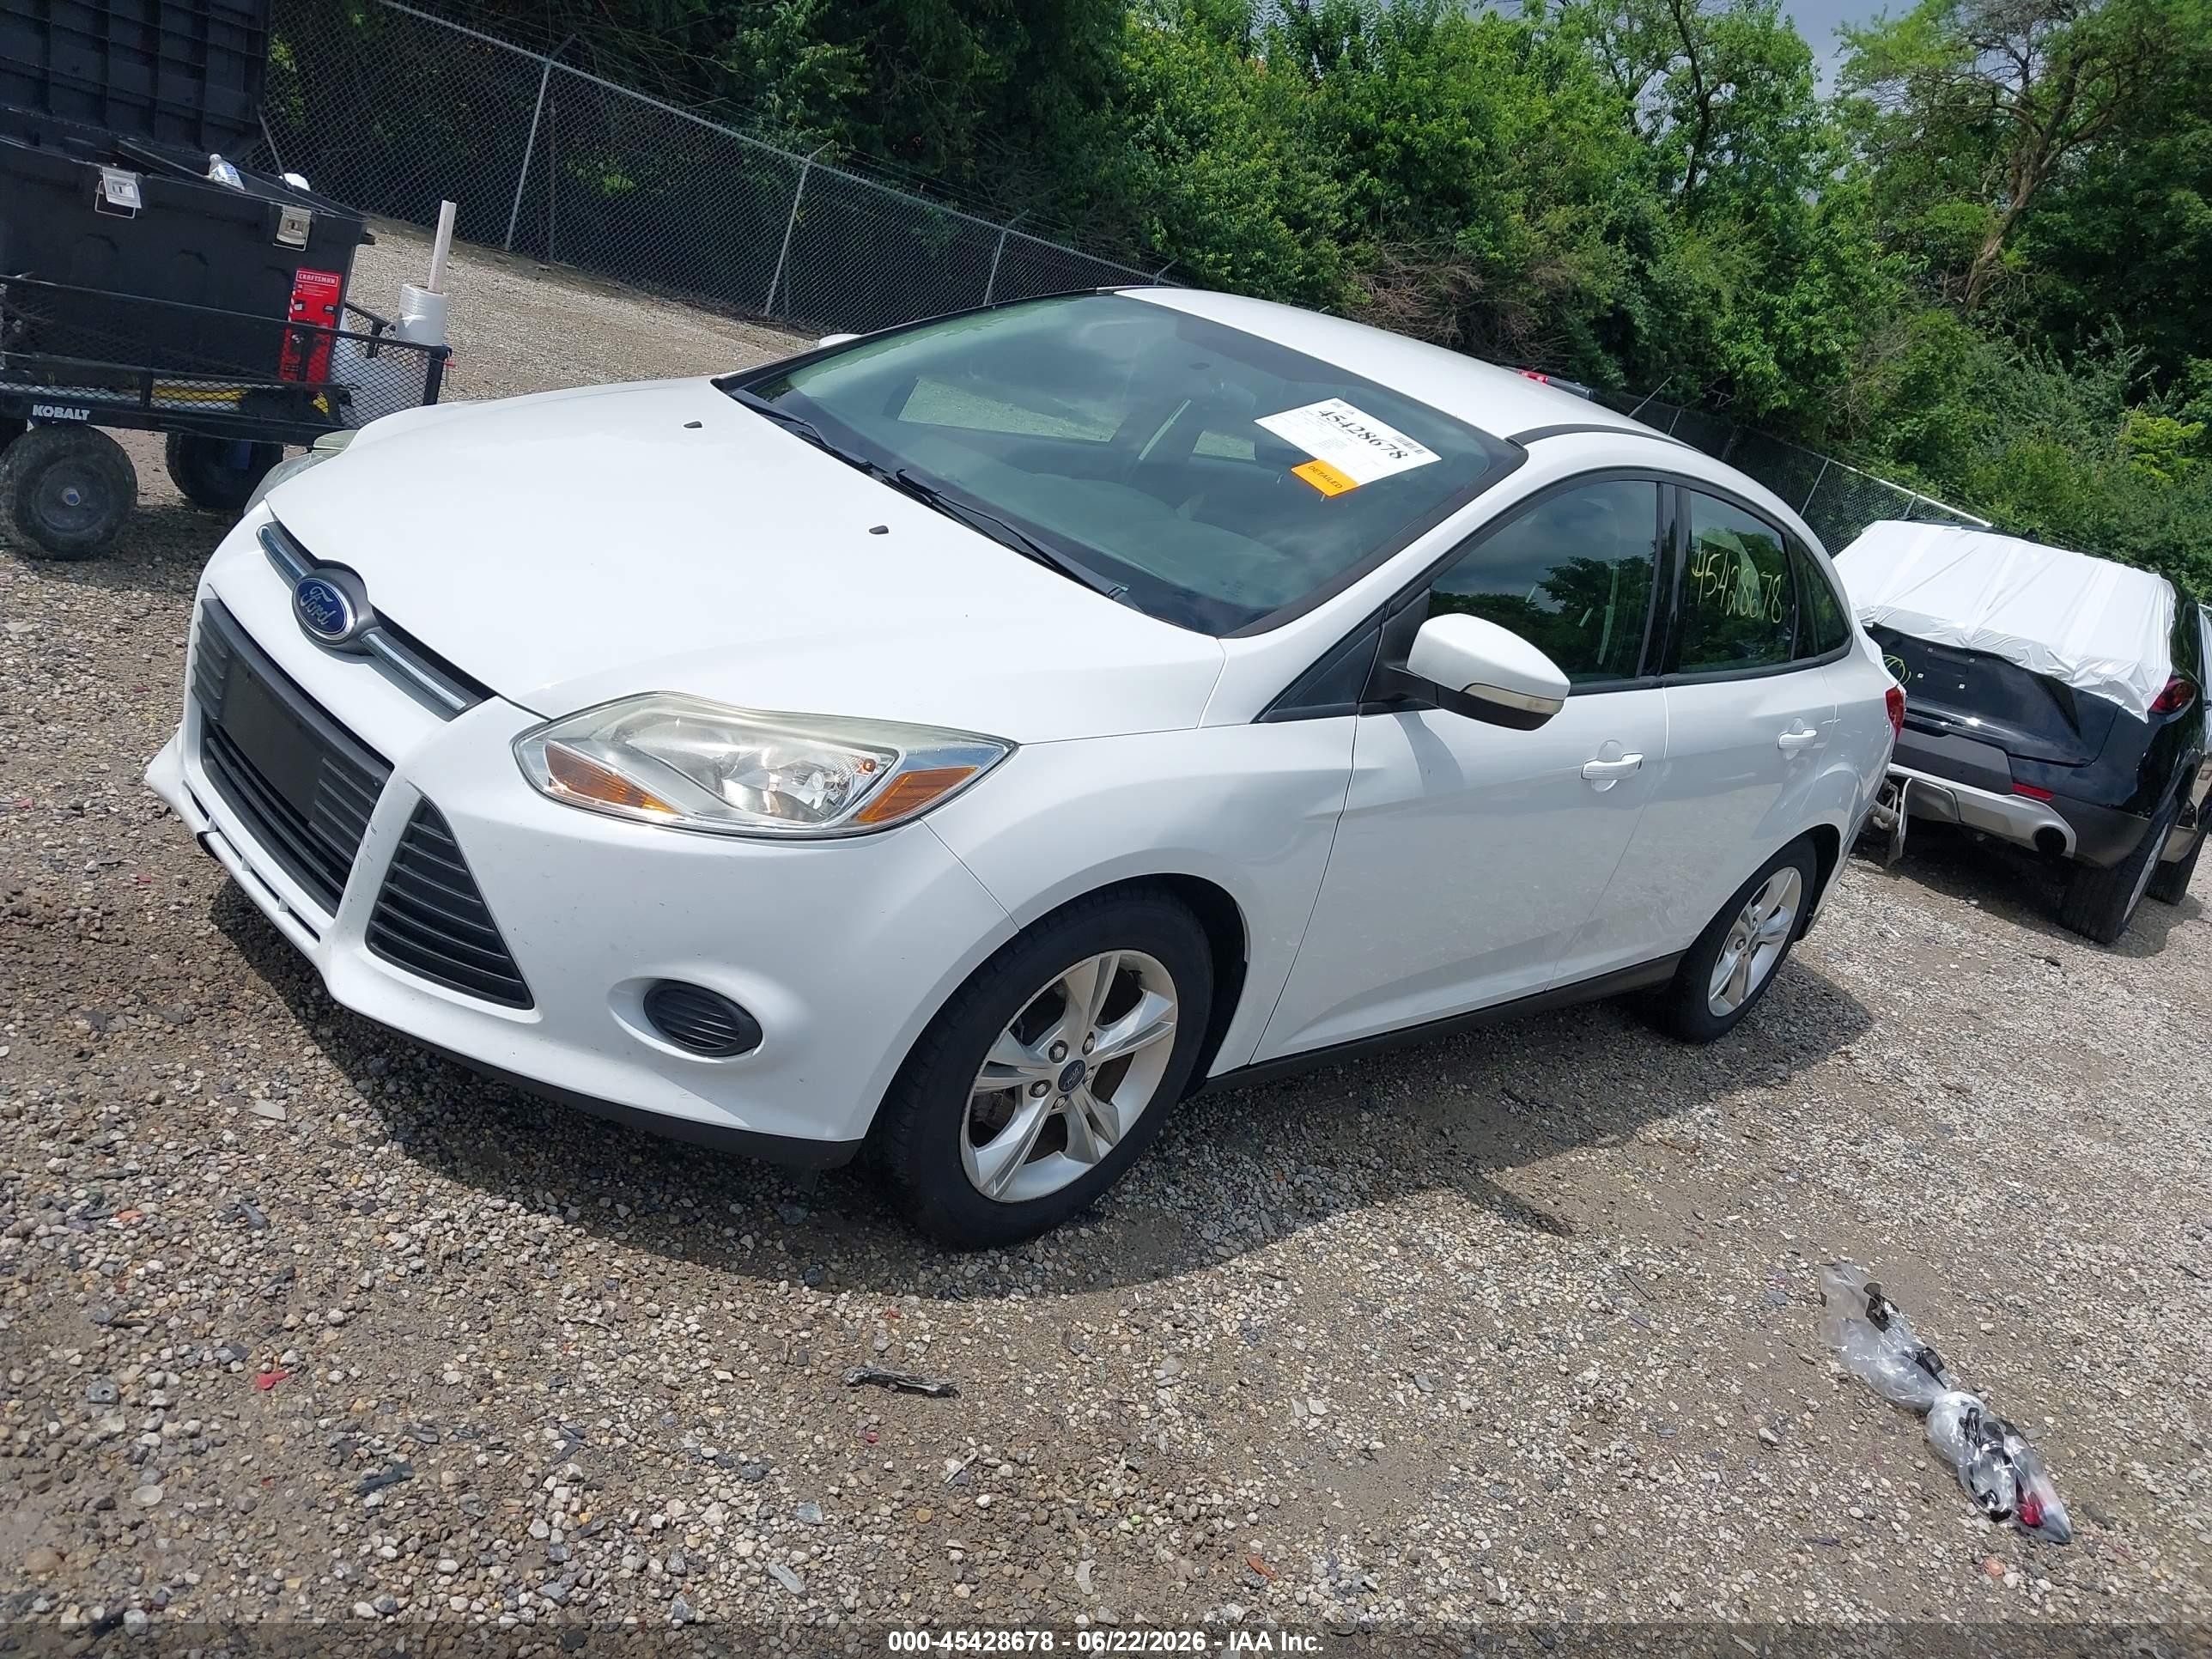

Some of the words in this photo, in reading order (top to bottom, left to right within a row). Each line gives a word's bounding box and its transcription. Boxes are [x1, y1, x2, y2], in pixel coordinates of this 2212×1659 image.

[299, 273, 336, 284] CRAFTSMAN
[32, 404, 89, 421] KOBALT
[1317, 409, 1409, 460] 45428678
[1307, 465, 1344, 489] DETAILED
[1691, 539, 1784, 623] 45428678
[300, 586, 337, 625] Ford
